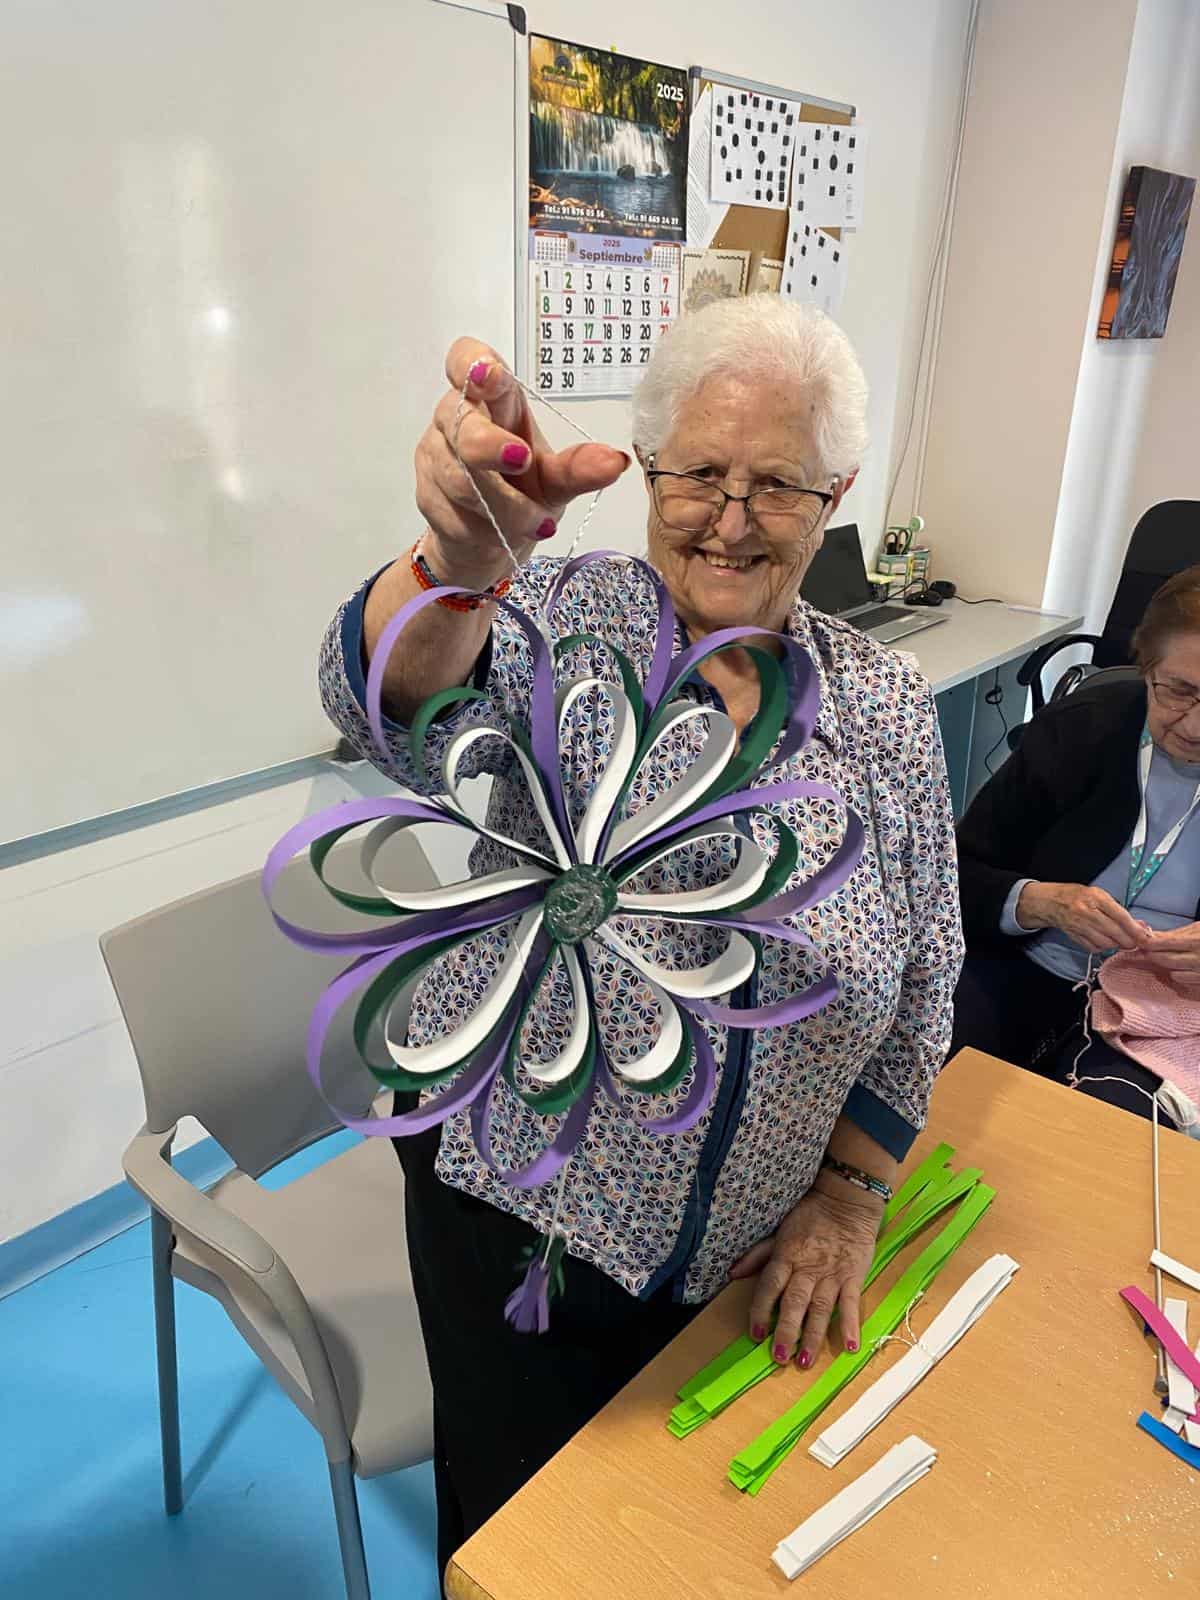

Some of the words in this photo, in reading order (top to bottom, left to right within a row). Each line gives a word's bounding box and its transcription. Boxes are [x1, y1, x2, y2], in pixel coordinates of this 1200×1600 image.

[657, 83, 684, 101] 2025
[602, 239, 621, 248] 2025
[579, 249, 643, 264] Septiembre
[544, 270, 549, 288] 1
[565, 272, 572, 288] 2
[586, 273, 593, 290] 3
[606, 274, 612, 291] 4
[624, 275, 631, 292] 5
[644, 276, 650, 293] 6
[662, 277, 669, 293] 7
[543, 296, 550, 313] 8
[565, 297, 572, 314] 9
[584, 297, 595, 315] 10
[604, 299, 611, 315] 11
[622, 299, 632, 316] 12
[641, 300, 650, 316] 13
[660, 300, 670, 316] 14
[541, 322, 552, 340] 15
[563, 323, 574, 340] 16
[584, 323, 594, 339] 17
[603, 323, 612, 340] 18
[621, 323, 631, 340] 19
[640, 324, 651, 340] 20
[540, 347, 553, 364] 22
[562, 347, 574, 364] 23
[583, 347, 595, 363] 24
[602, 347, 612, 363] 25
[620, 347, 632, 363] 26
[640, 347, 650, 363] 27
[540, 372, 553, 389] 29
[562, 371, 574, 389] 30
